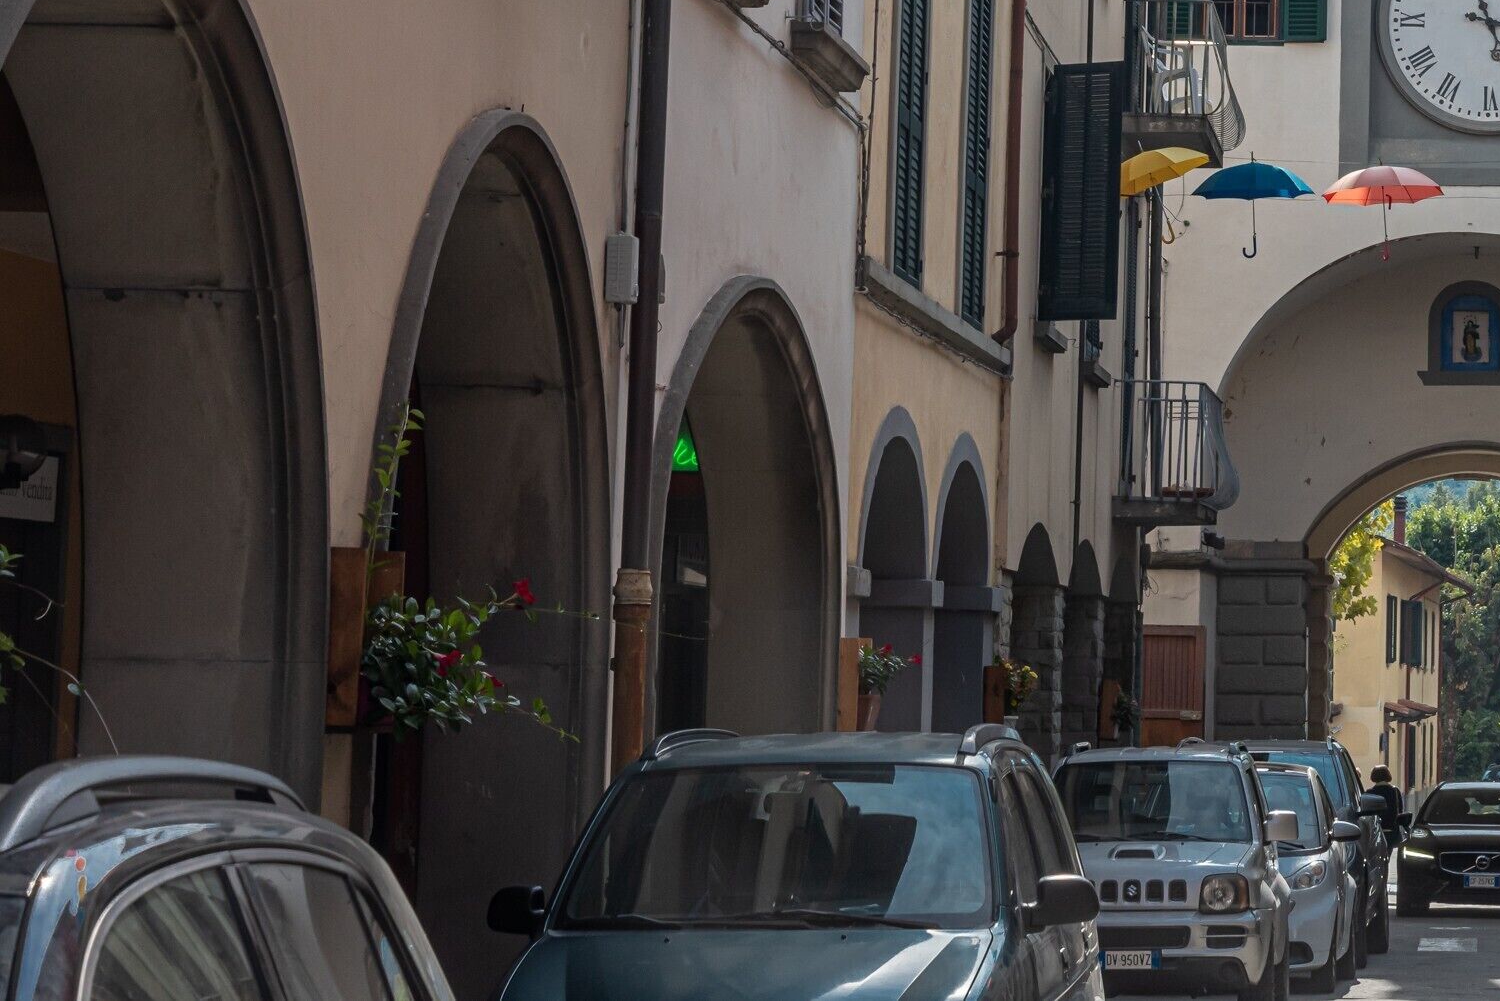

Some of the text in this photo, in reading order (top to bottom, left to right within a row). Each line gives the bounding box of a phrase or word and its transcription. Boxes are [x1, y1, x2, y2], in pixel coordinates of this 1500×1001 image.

[1400, 11, 1426, 28] IX
[1106, 953, 1151, 967] DV 950VZ
